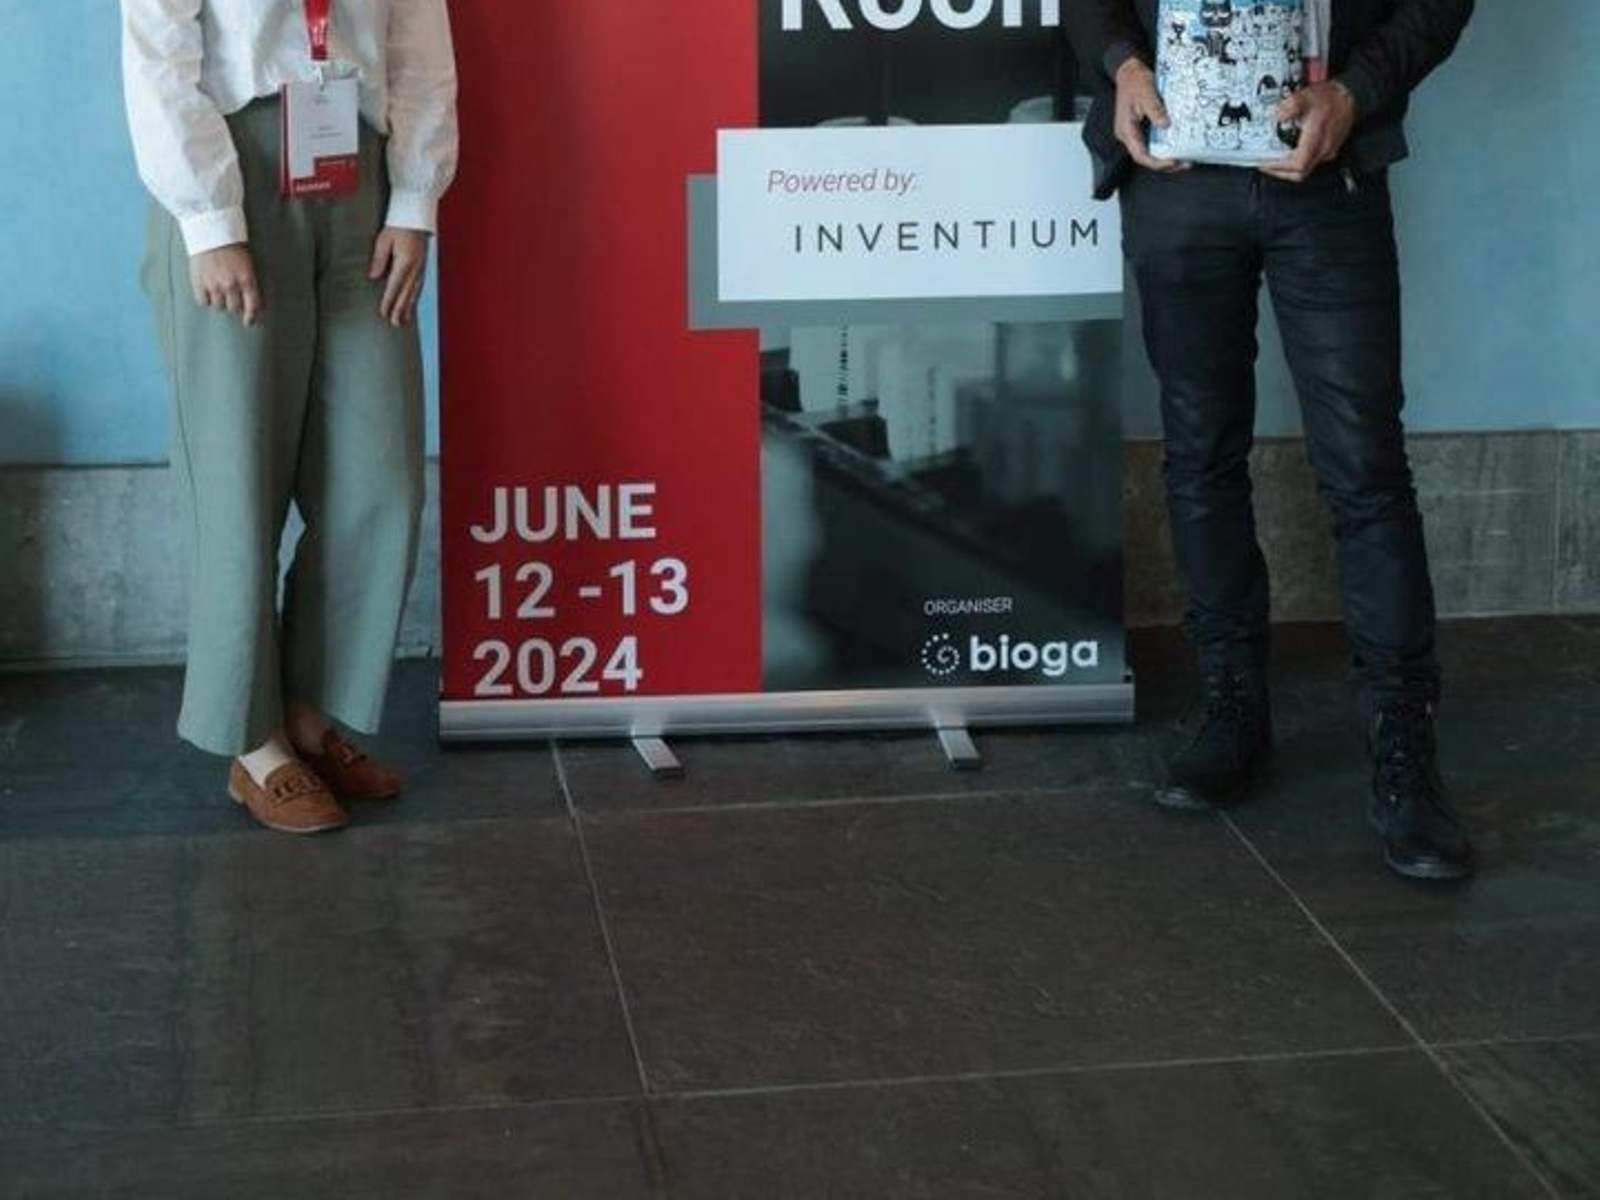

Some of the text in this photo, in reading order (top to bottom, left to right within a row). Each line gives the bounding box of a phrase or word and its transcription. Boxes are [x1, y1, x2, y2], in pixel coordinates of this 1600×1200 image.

[768, 169, 878, 193] Powered
[795, 218, 1099, 253] INVENTIUM
[470, 483, 657, 543] JUNE
[475, 561, 556, 619] 12
[924, 597, 1013, 615] ORGANISER
[472, 635, 643, 695] 2024
[970, 634, 1099, 676] bioga
